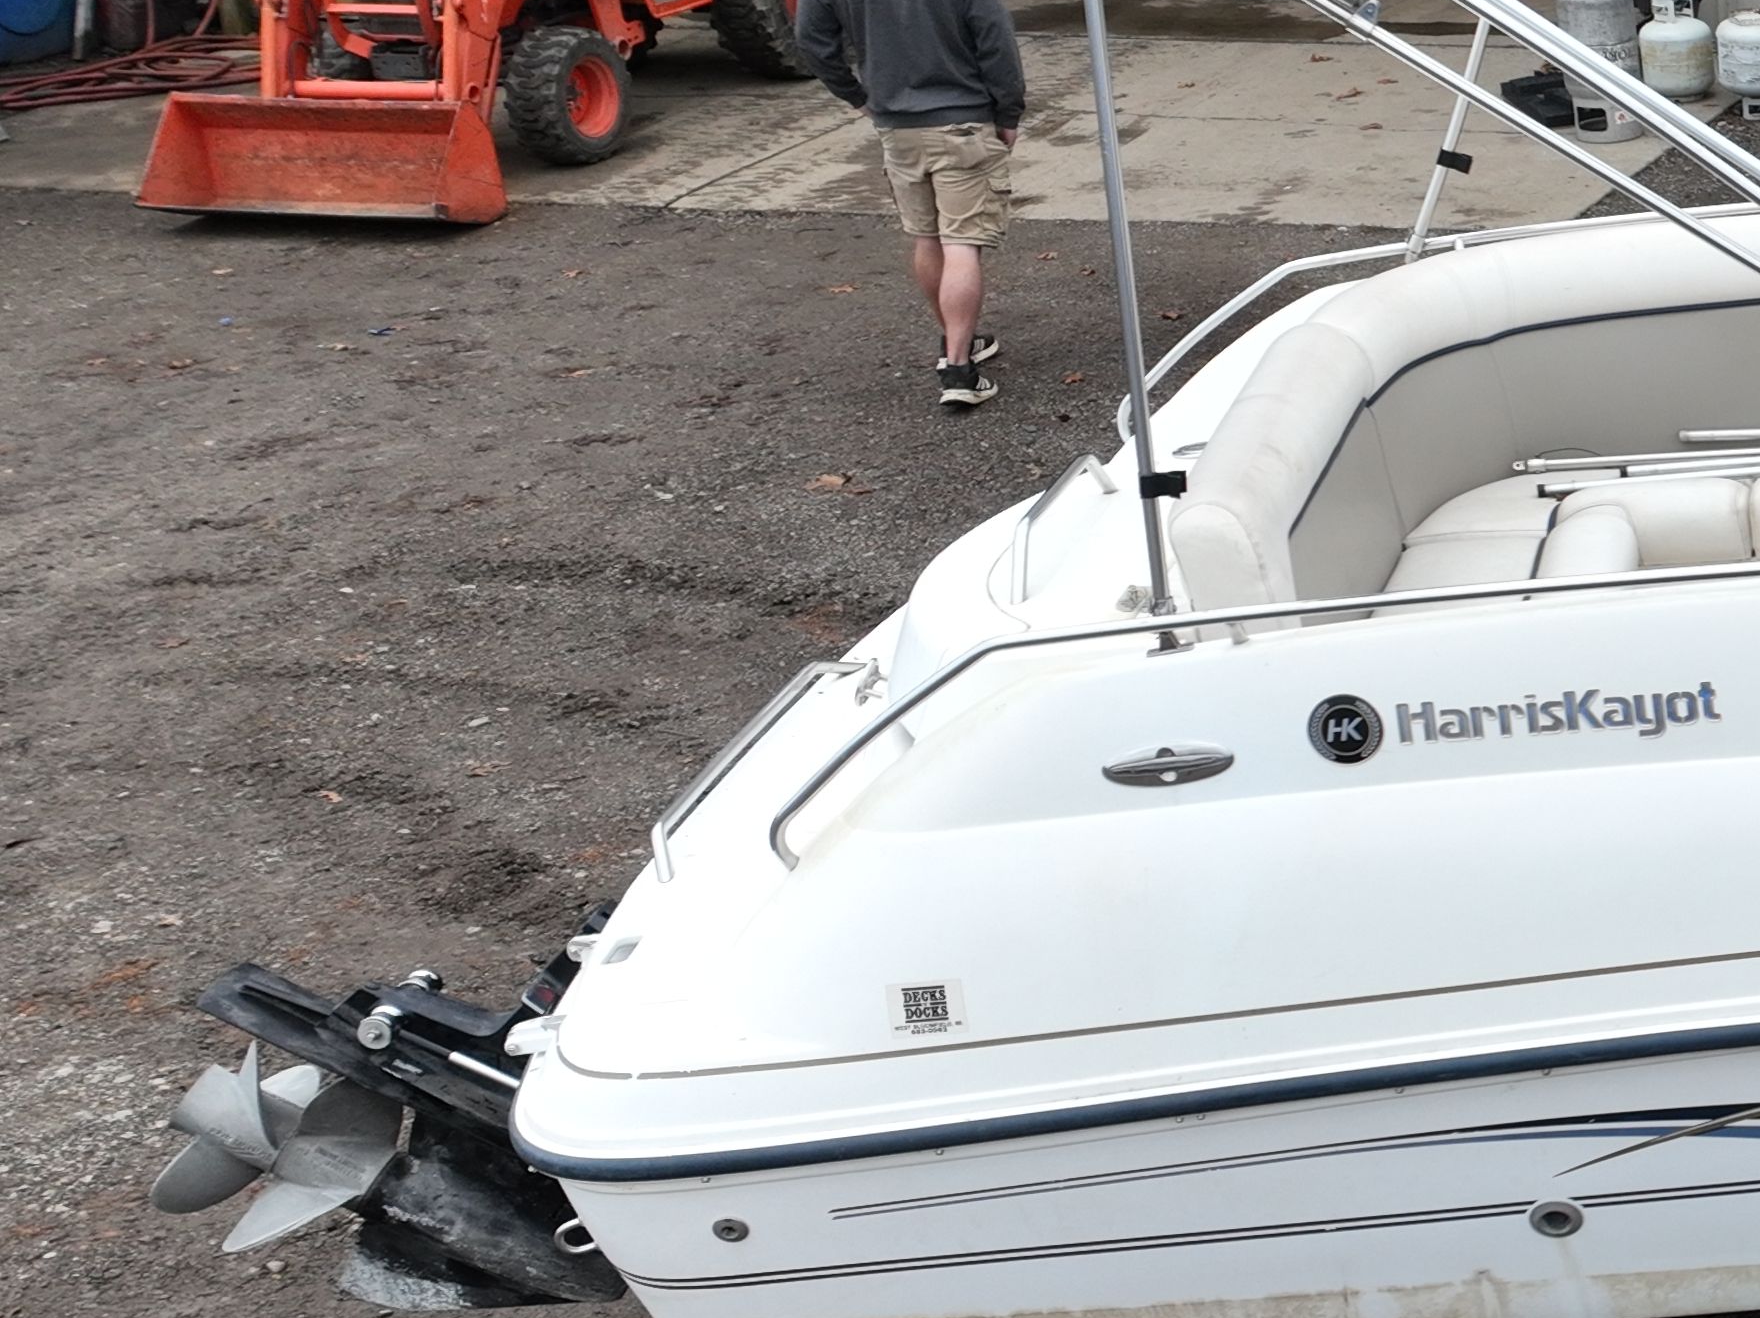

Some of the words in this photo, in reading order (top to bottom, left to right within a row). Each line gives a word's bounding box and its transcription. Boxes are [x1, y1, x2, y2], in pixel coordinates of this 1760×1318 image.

[1326, 716, 1365, 744] HK
[1395, 681, 1722, 746] HarrisKayot
[902, 989, 947, 1003] DECKS
[904, 1005, 949, 1020] DOCKS
